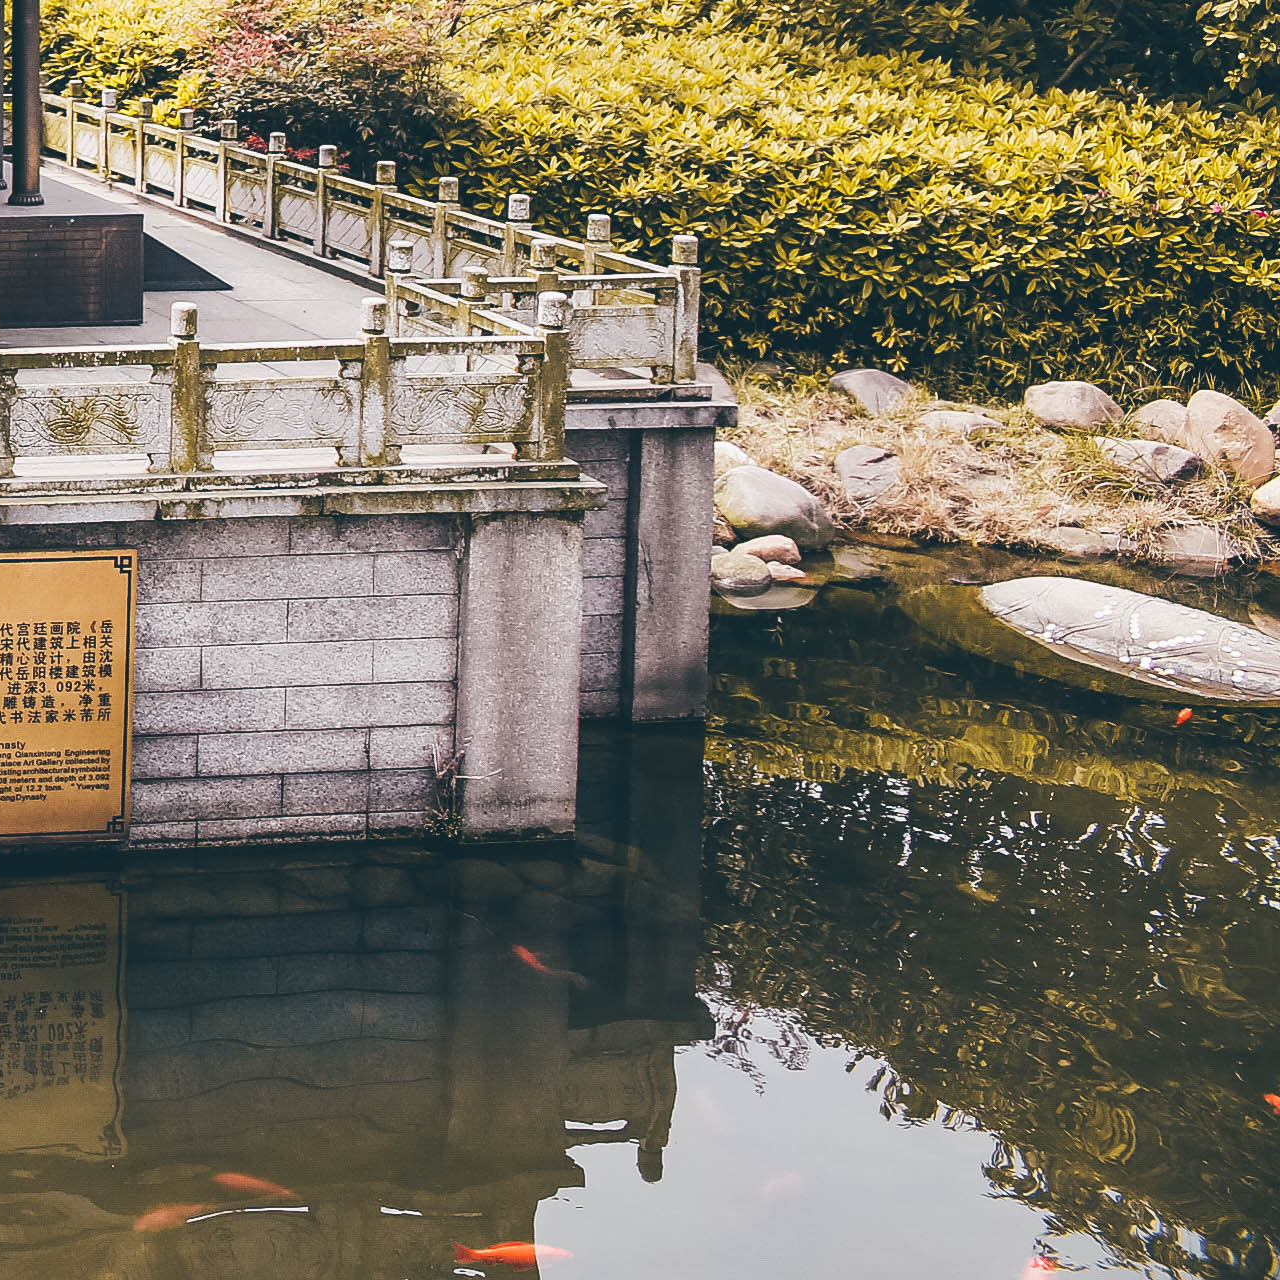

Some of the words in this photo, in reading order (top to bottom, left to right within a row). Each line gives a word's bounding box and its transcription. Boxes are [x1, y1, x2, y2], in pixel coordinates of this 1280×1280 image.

[64, 748, 111, 758] Engineering
[23, 759, 34, 767] Art
[36, 758, 64, 767] Gallery
[101, 756, 111, 765] by
[9, 776, 35, 784] meters
[38, 775, 52, 783] and
[55, 774, 76, 783] depth
